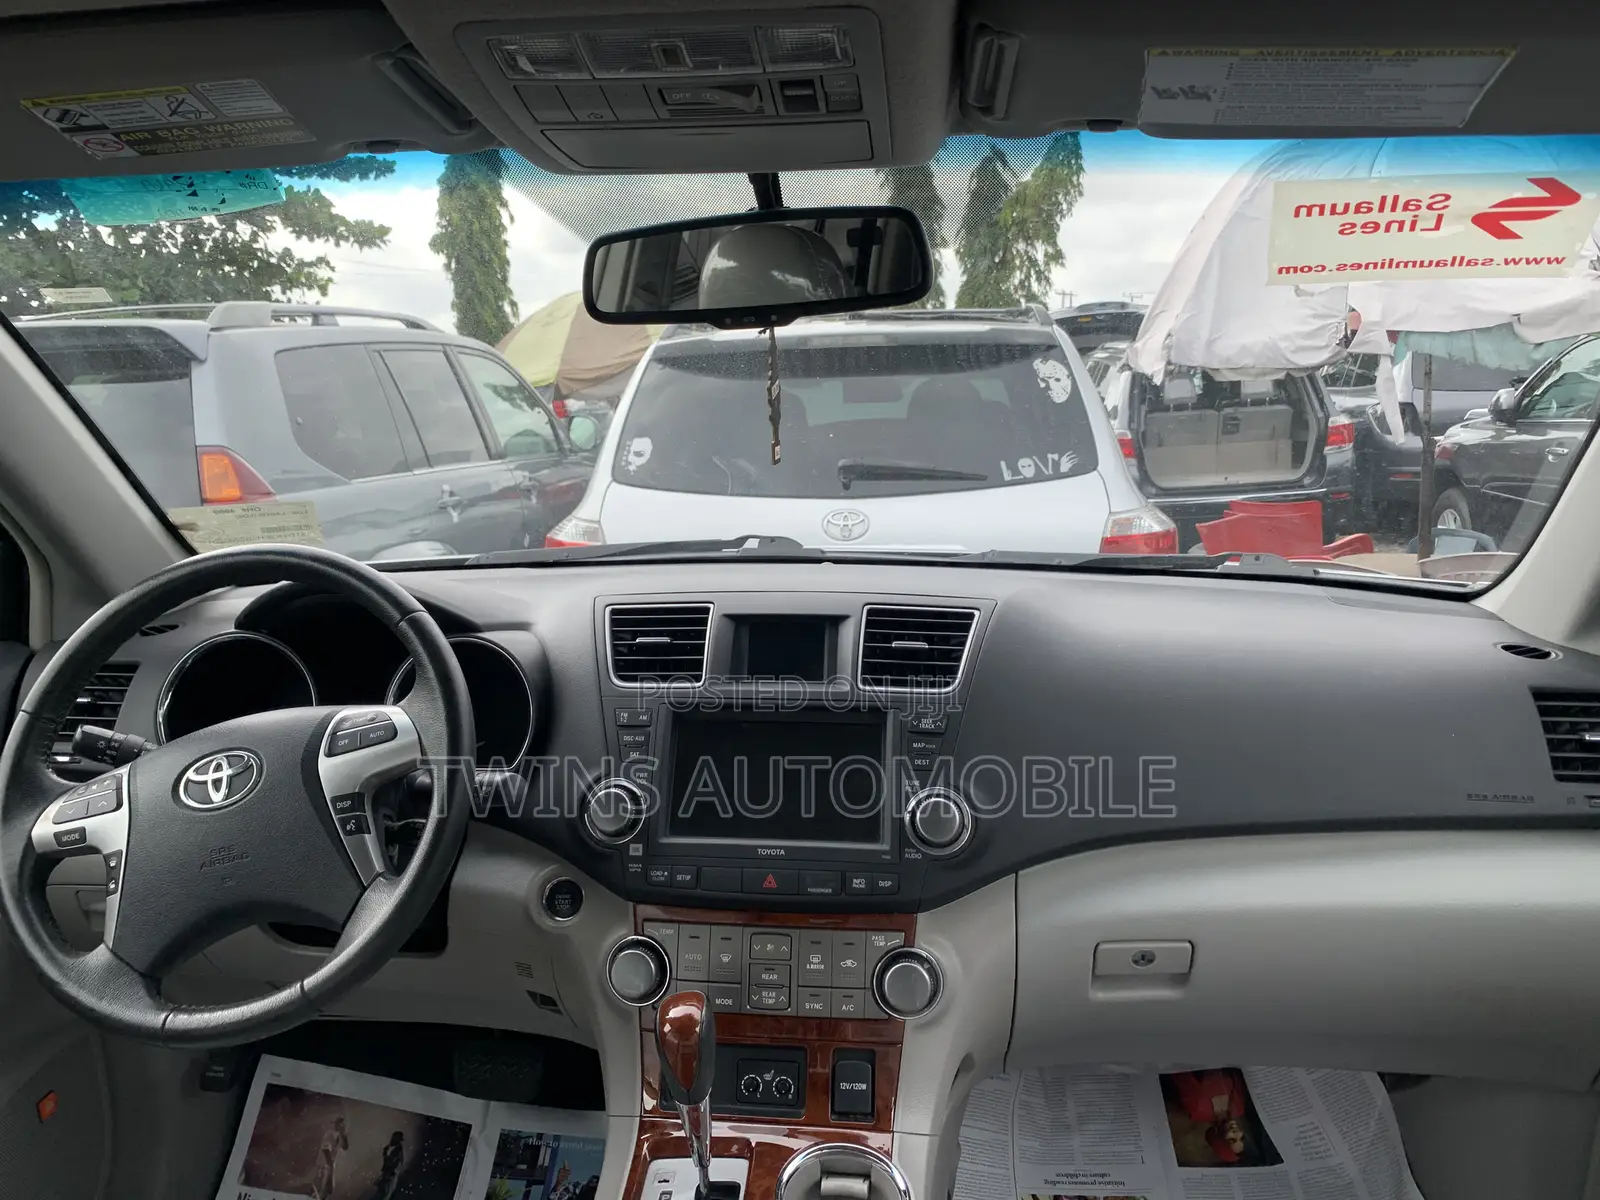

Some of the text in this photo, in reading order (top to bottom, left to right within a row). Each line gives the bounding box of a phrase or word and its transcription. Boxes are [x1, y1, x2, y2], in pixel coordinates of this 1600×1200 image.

[672, 92, 691, 100] OFF
[119, 132, 152, 142] AIR
[157, 127, 200, 138] BAG
[204, 118, 295, 133] WARNING
[369, 730, 385, 738] AUTO
[338, 739, 349, 747] OFF
[336, 800, 352, 809] DISP
[61, 832, 80, 842] MODE
[209, 844, 236, 857] SRS
[757, 848, 786, 856] TOYOTA
[200, 852, 249, 870] AIRBAG
[684, 953, 703, 961] AUTO
[761, 973, 778, 981] REAR
[715, 998, 733, 1006] MODE
[805, 1002, 823, 1010] SYNC
[841, 1003, 855, 1011] A/C
[840, 1082, 867, 1090] 12V/120W
